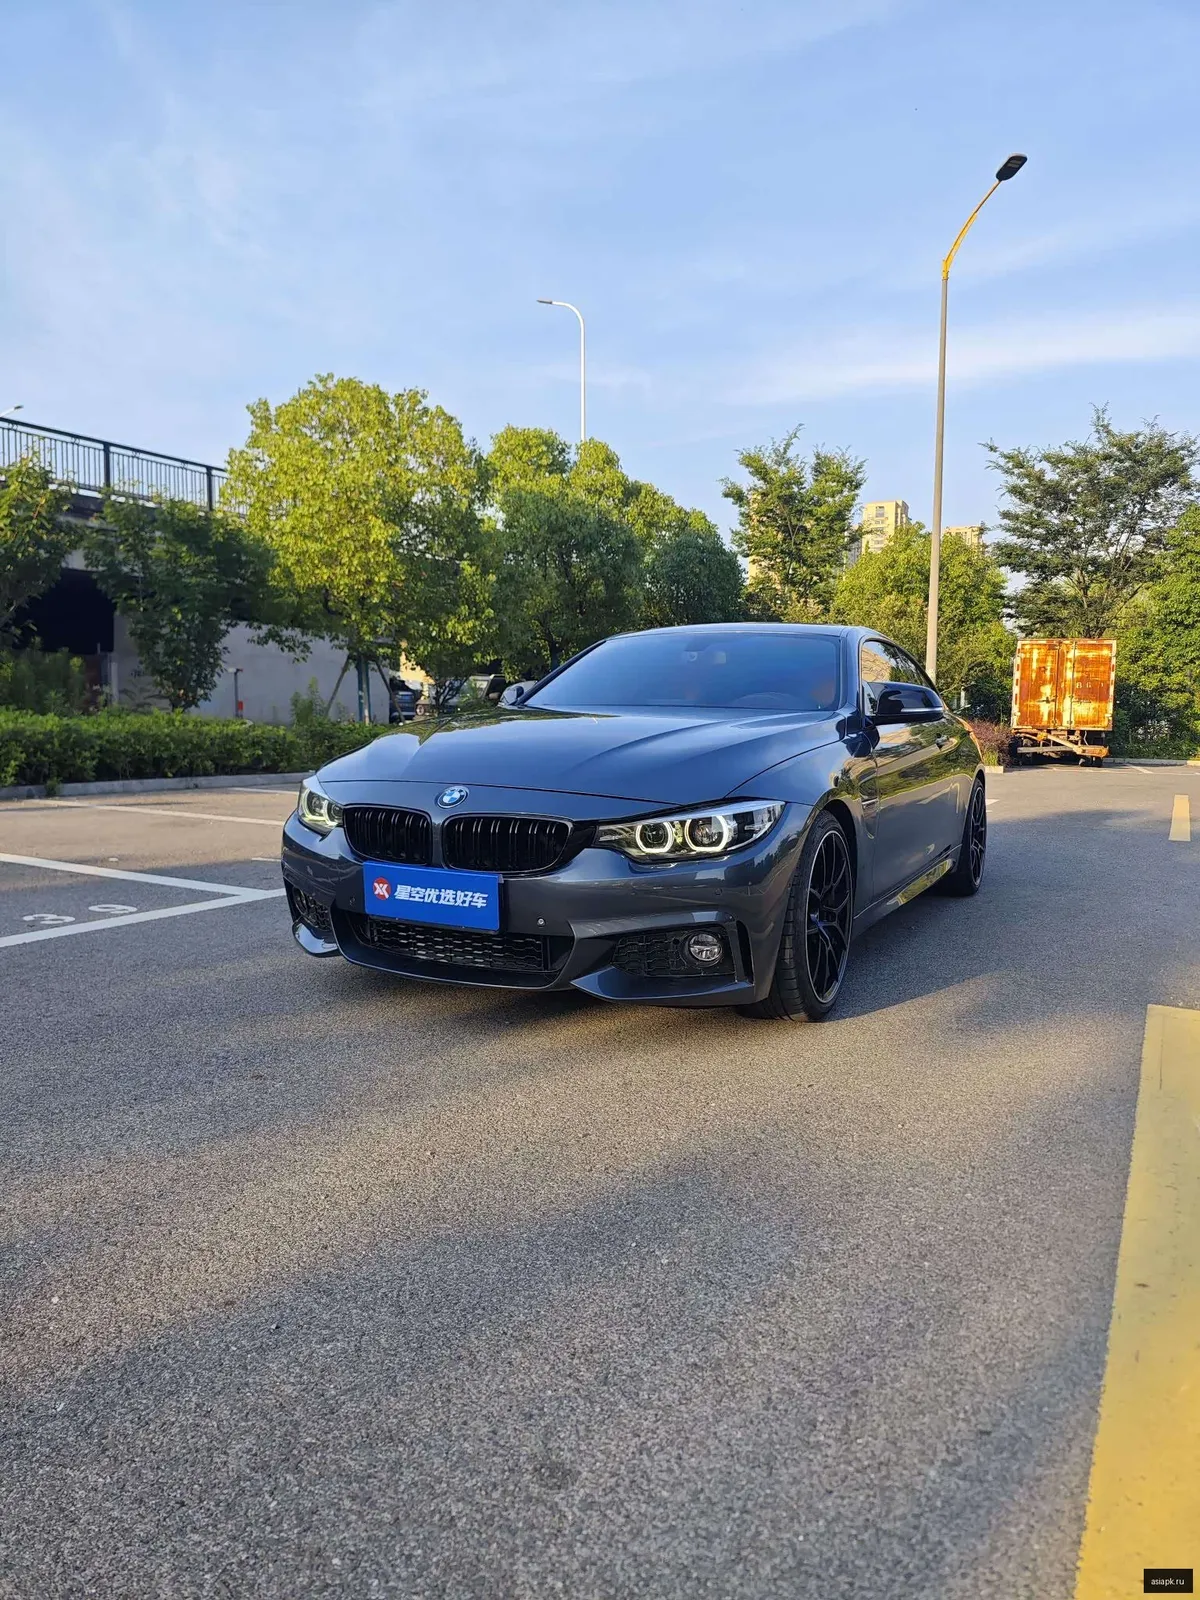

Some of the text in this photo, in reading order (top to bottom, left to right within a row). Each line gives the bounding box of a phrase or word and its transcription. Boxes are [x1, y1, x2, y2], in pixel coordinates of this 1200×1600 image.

[394, 884, 488, 908] 星空优选好车
